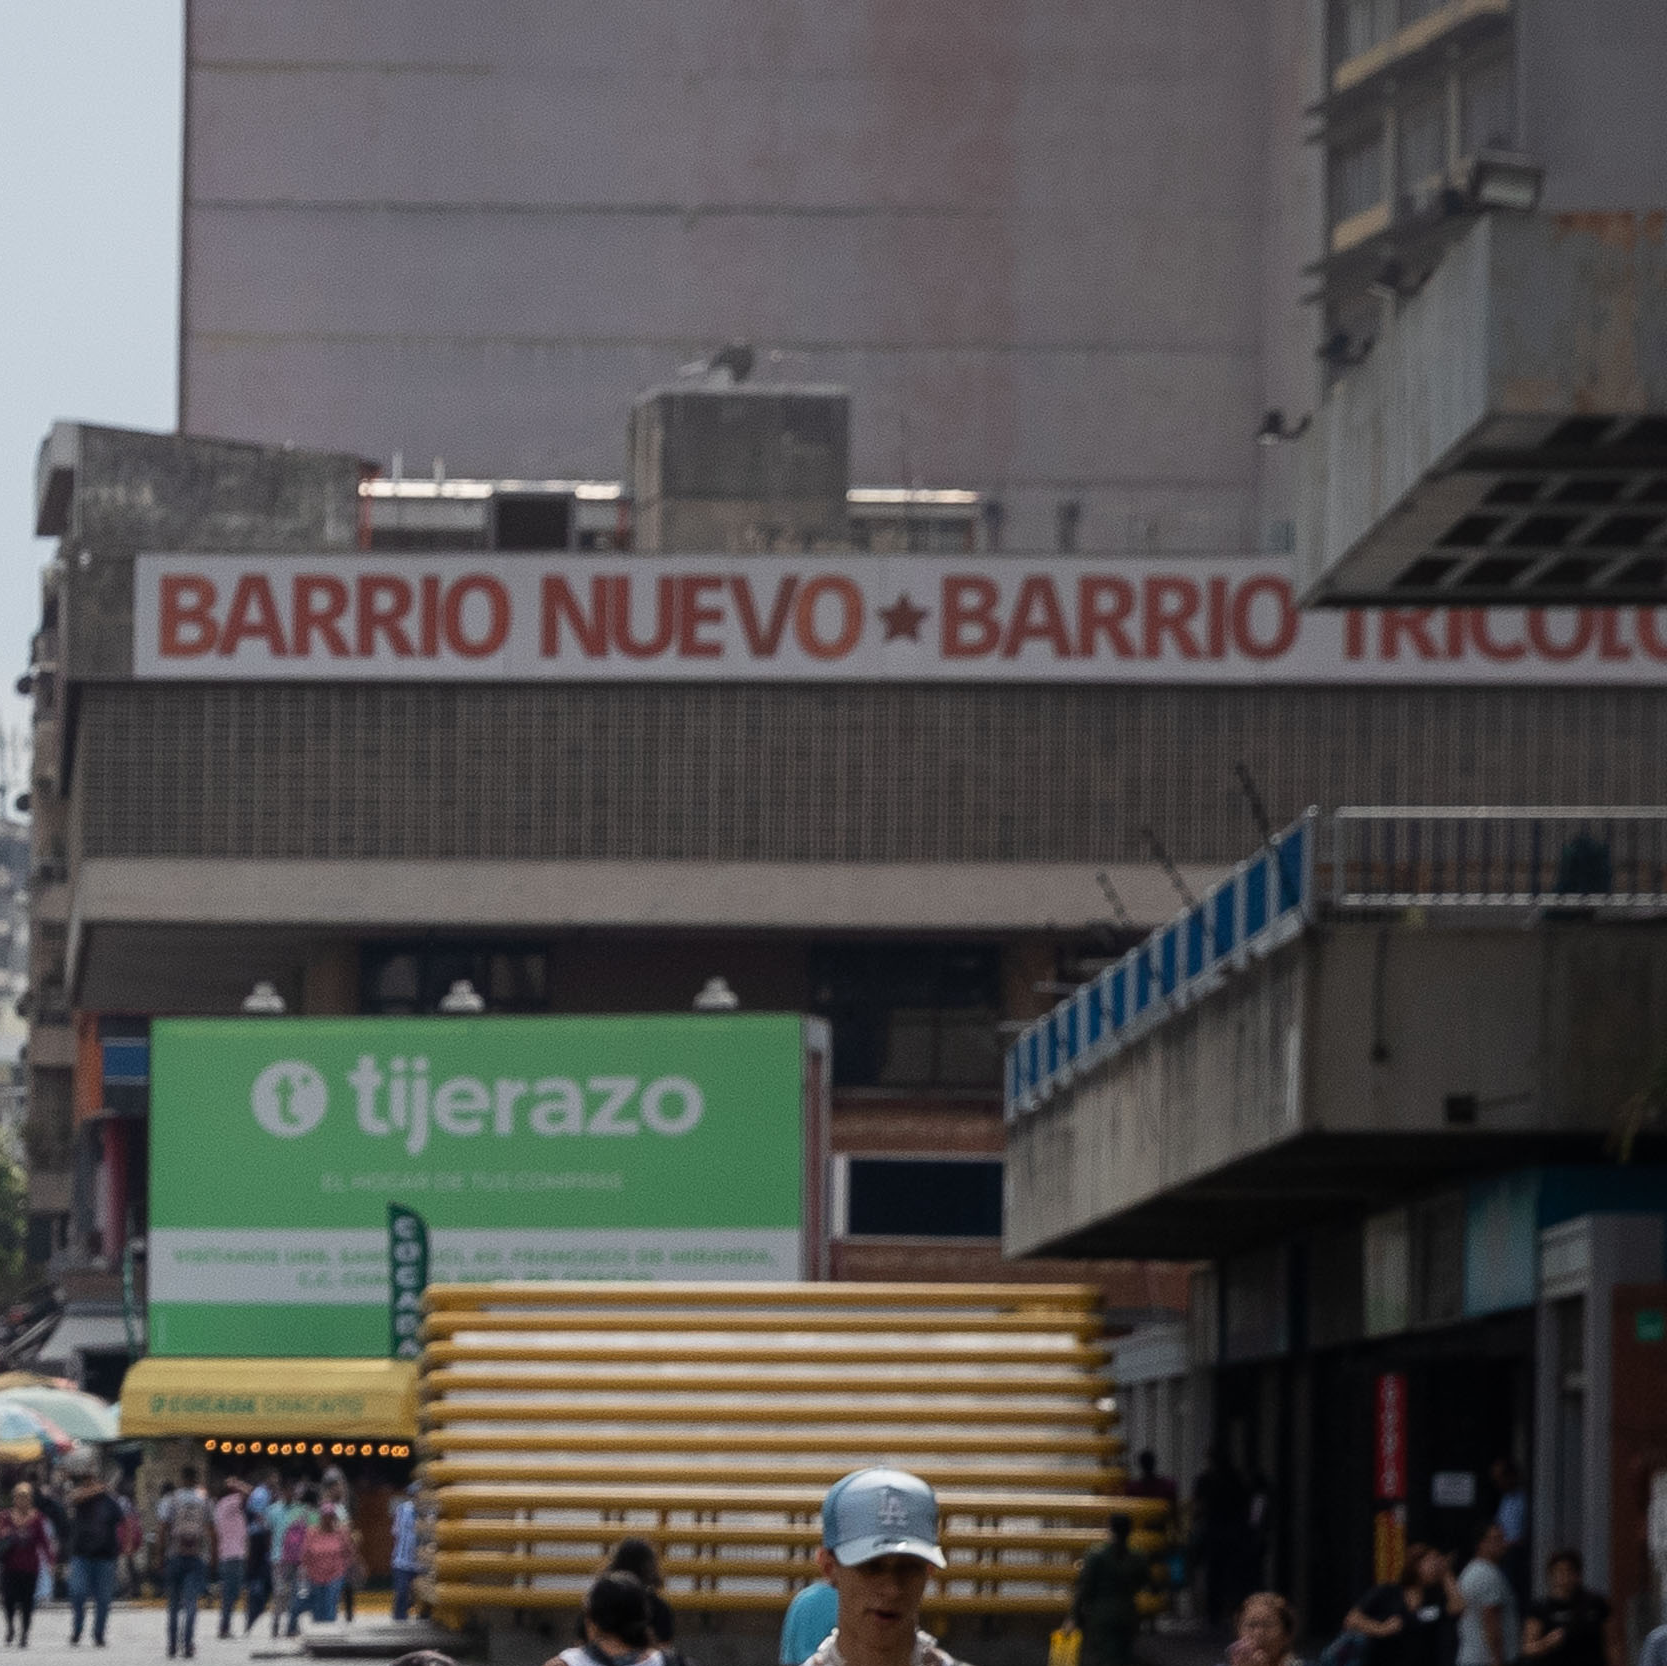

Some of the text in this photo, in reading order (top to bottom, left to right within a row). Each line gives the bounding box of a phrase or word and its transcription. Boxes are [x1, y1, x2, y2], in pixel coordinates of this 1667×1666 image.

[158, 574, 511, 659] BARRIO
[540, 574, 864, 659] NUEVO
[939, 574, 1301, 660] BARRIO
[348, 1054, 705, 1156] tijerazo
